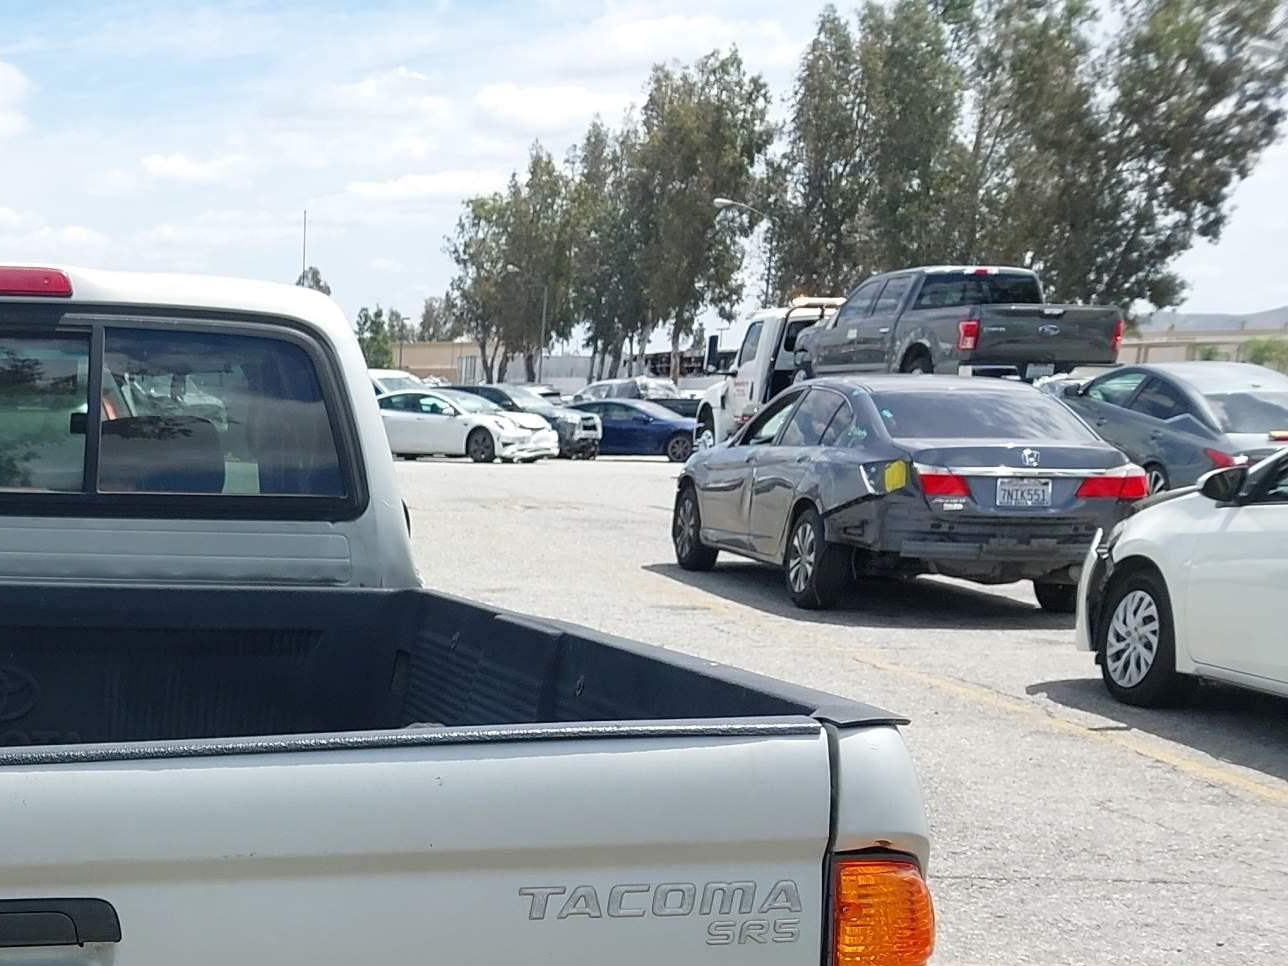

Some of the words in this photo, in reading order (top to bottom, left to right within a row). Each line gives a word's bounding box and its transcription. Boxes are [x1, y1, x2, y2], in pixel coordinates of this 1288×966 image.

[1000, 487, 1046, 502] 7NTK551
[518, 879, 803, 921] TACOMA
[705, 918, 801, 946] SR5
